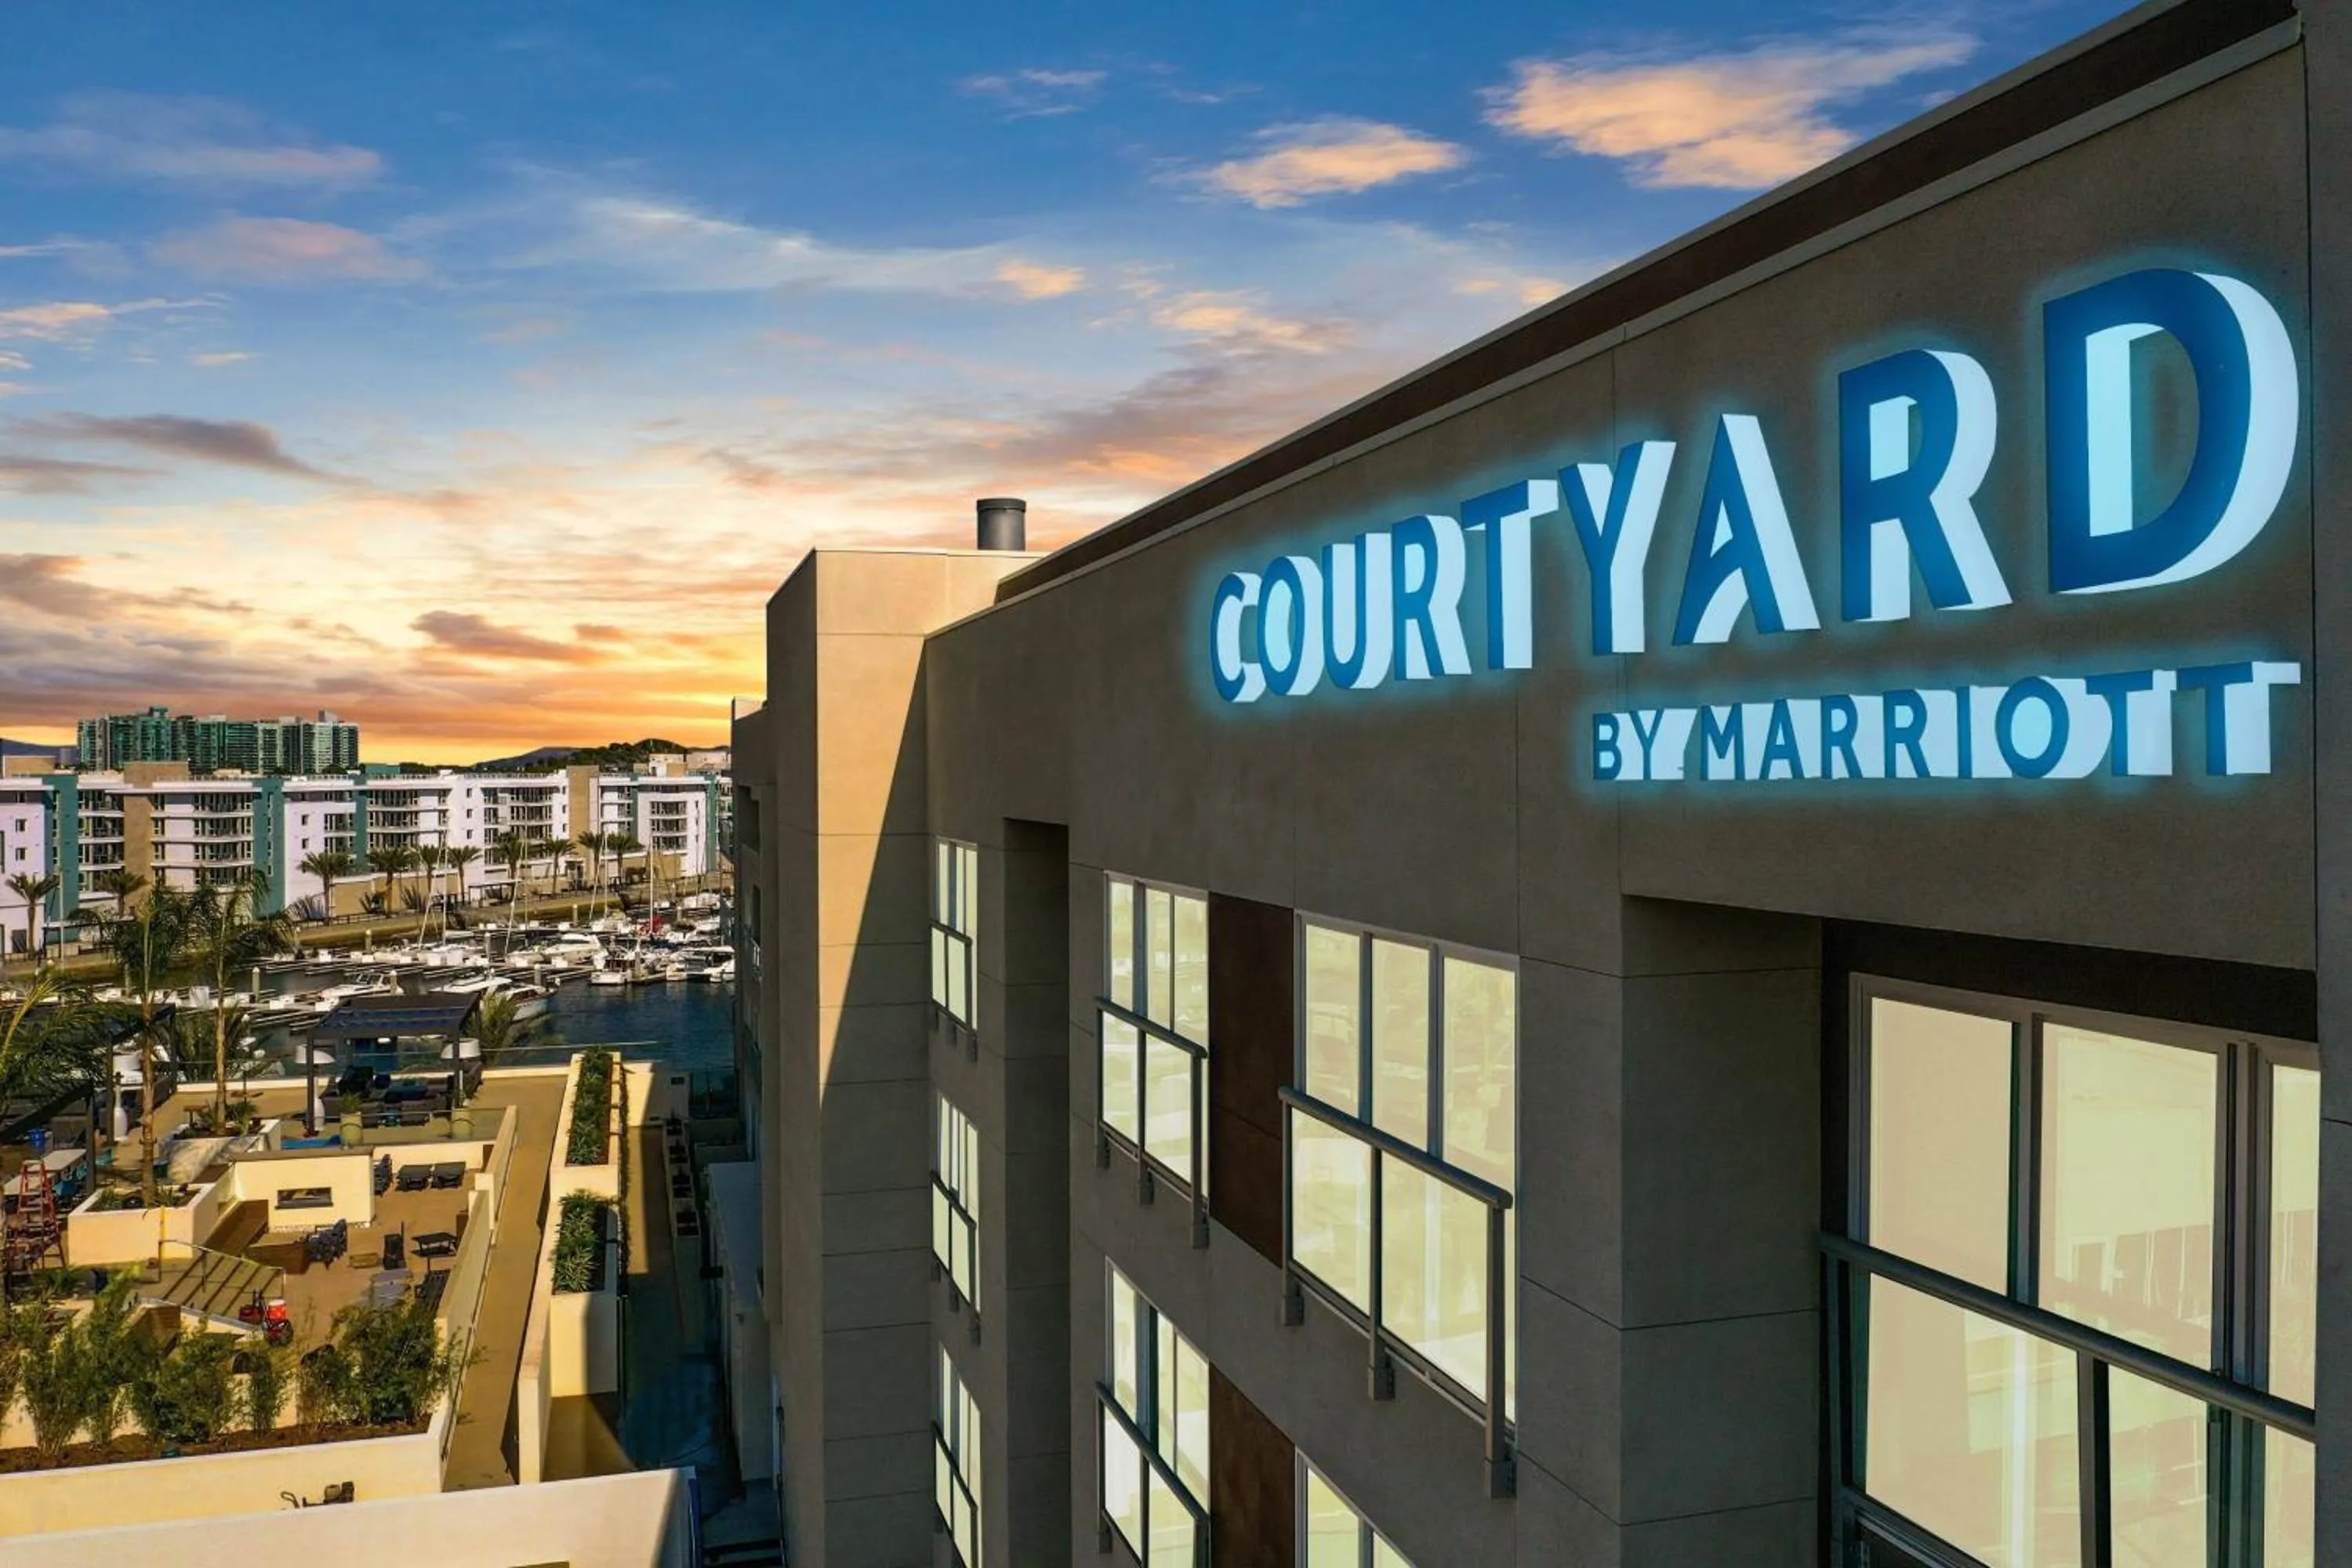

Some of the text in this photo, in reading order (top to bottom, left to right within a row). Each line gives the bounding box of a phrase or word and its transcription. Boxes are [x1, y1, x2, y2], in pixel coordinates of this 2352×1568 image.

[1211, 269, 2299, 702] COURTYARD
[1592, 662, 2299, 780] BY MARRIOTT
